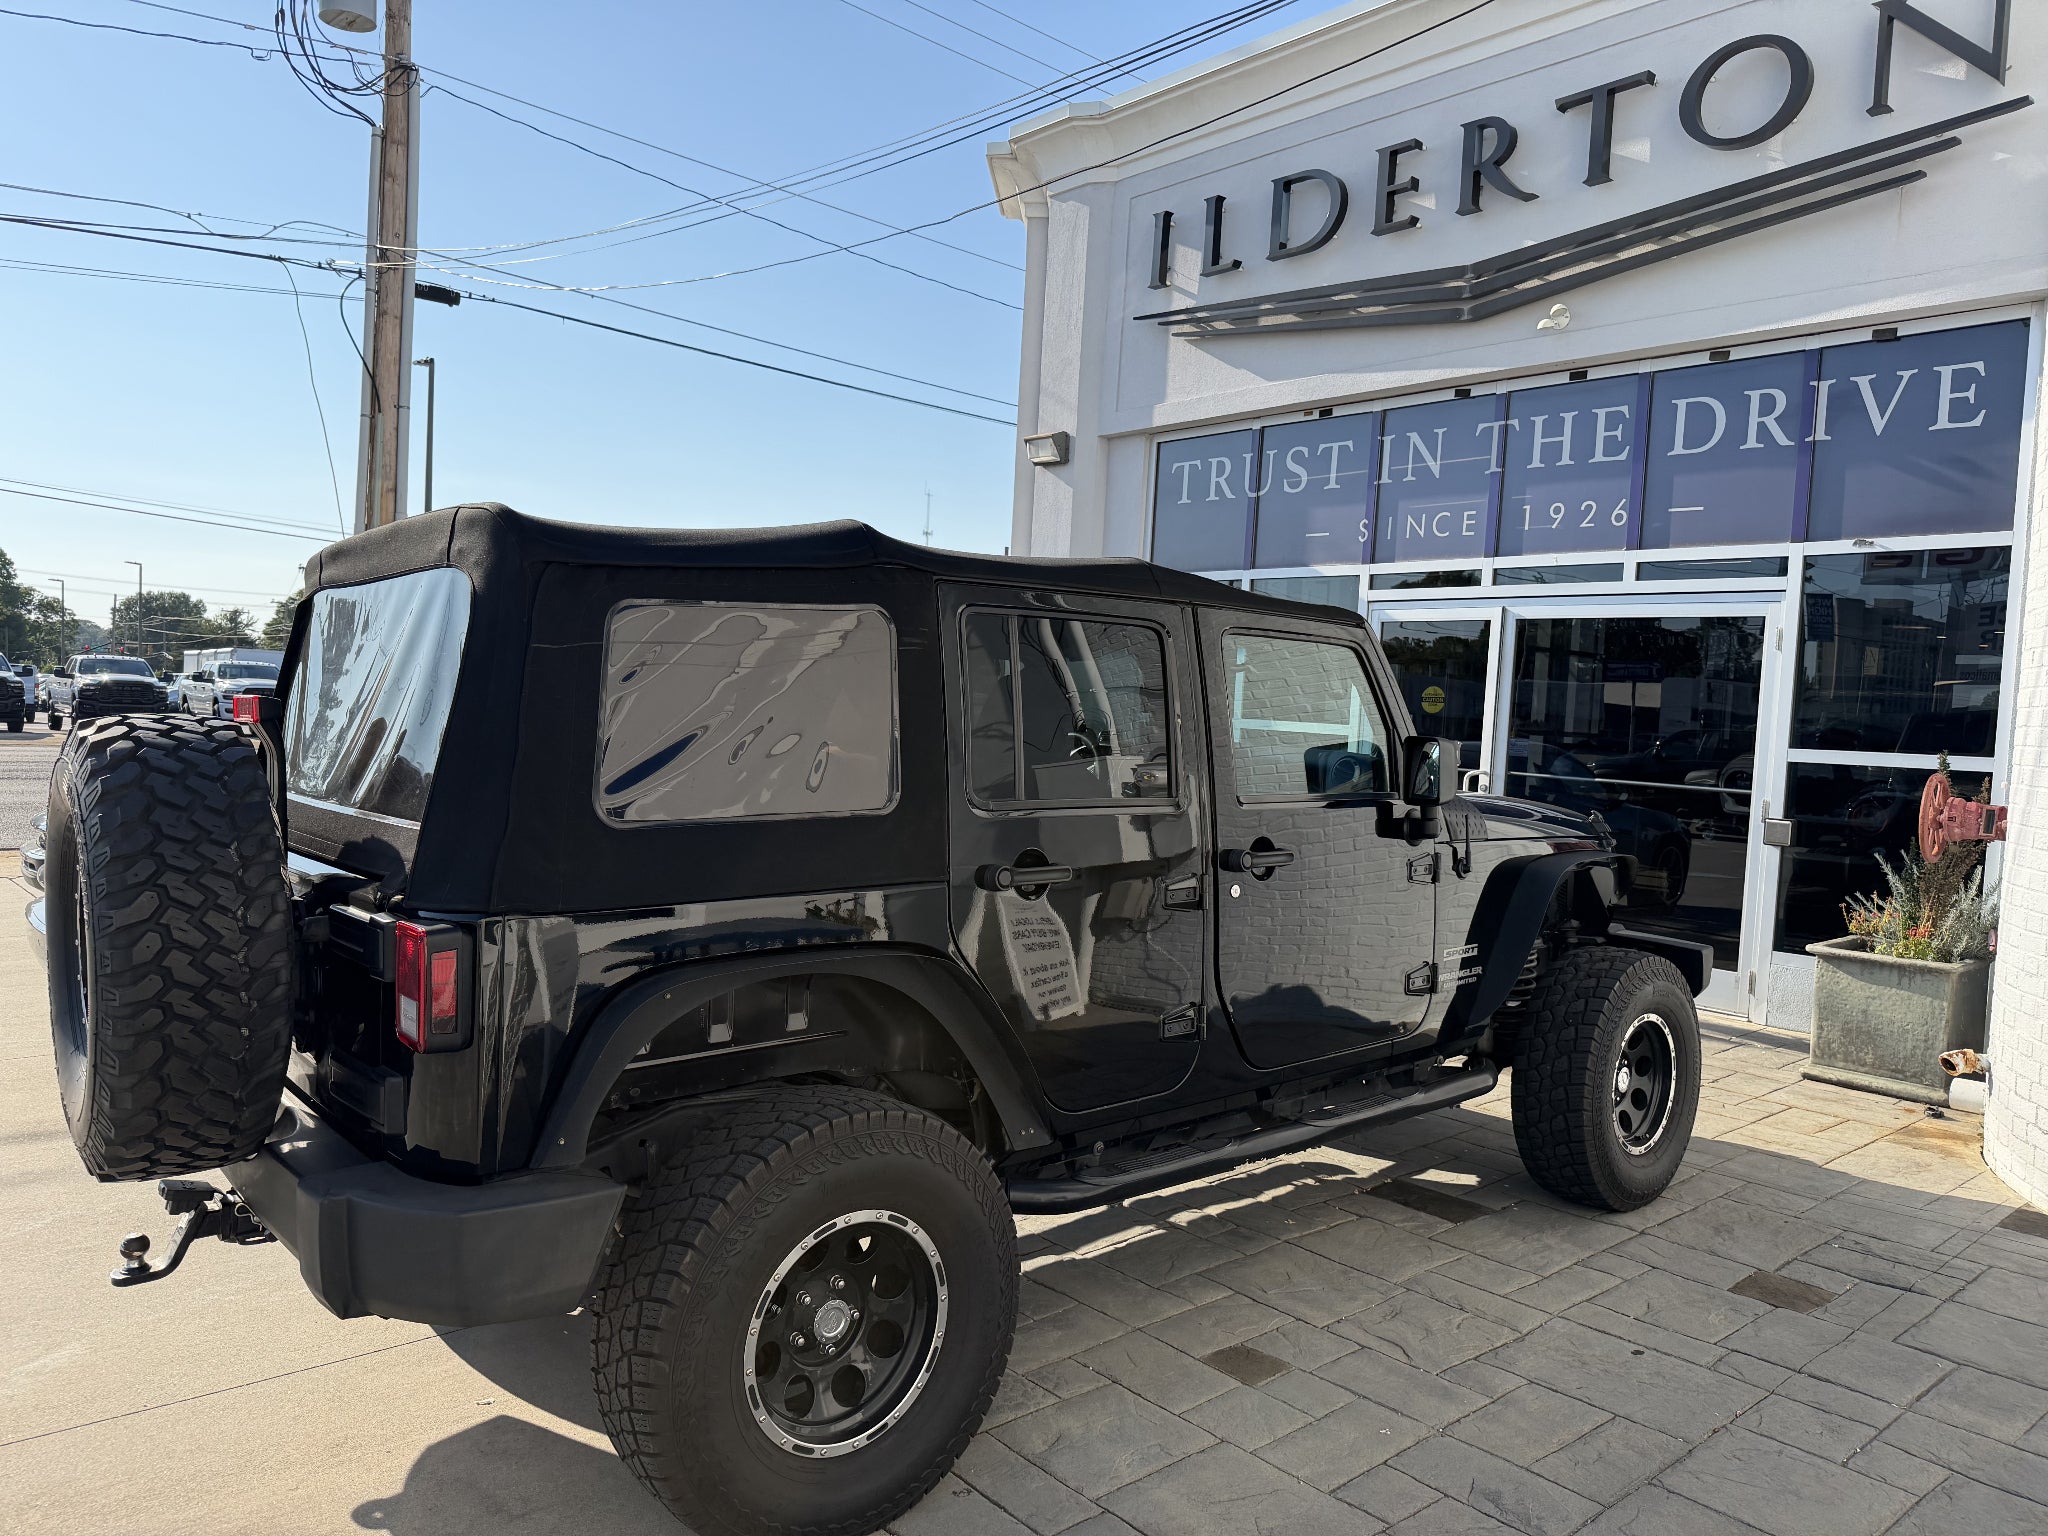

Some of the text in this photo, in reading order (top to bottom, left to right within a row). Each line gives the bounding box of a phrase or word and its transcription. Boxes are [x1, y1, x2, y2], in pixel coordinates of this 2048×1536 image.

[1147, 0, 2010, 290] ILDERTON
[1171, 360, 1989, 505] TRUST IN THE DRIVE
[1358, 498, 1629, 542] SINCE 1926
[1439, 966, 1482, 982] WRANGLER
[1445, 947, 1475, 957] SPORT
